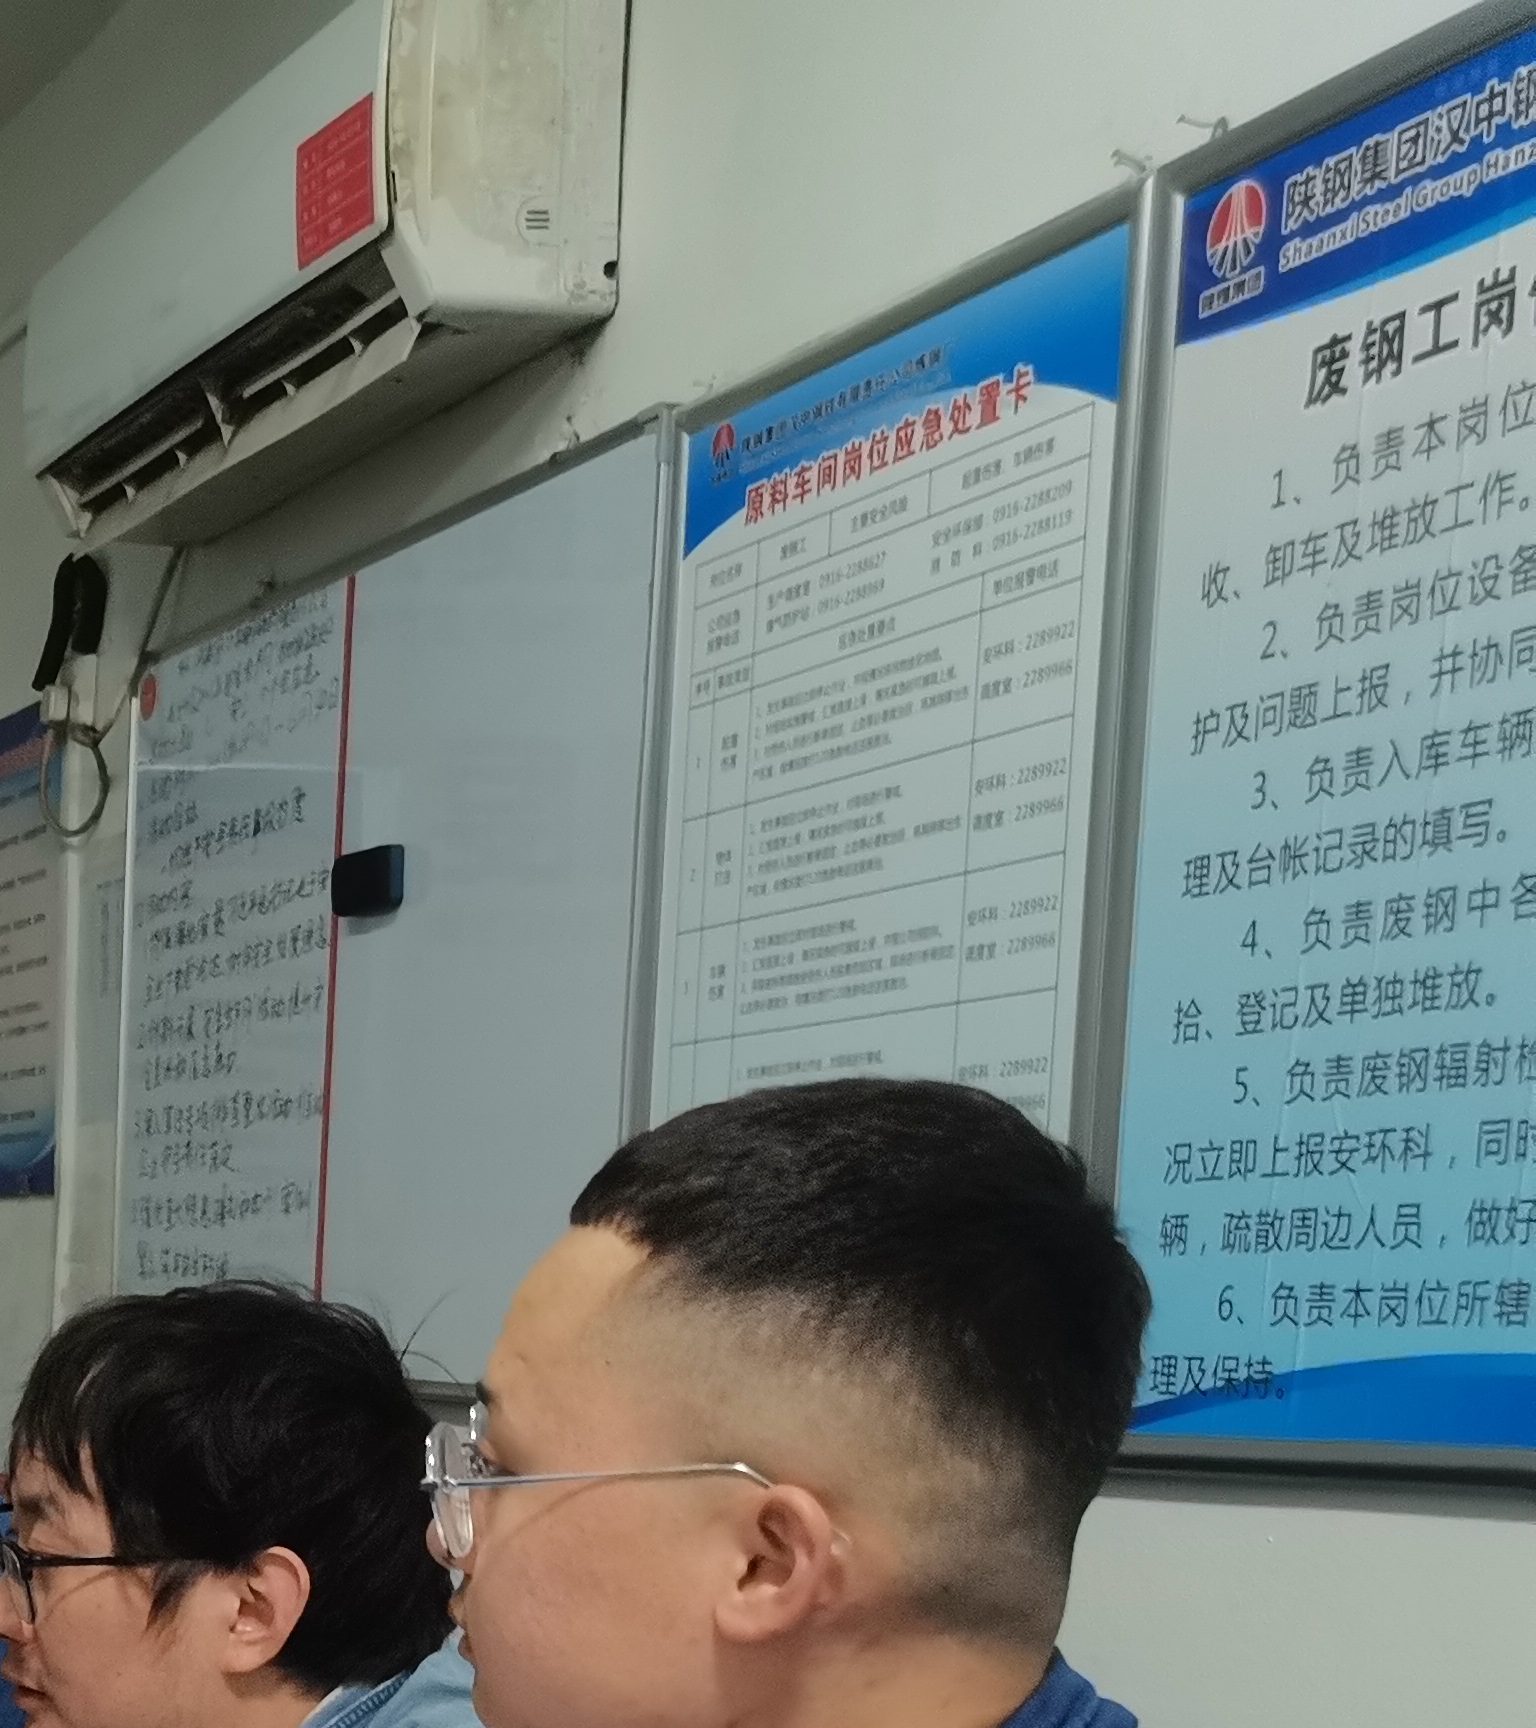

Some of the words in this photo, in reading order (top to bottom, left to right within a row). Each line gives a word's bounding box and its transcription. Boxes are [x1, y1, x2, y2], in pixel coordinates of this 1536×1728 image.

[1360, 190, 1410, 234] Steel
[1415, 166, 1479, 211] Group
[1304, 266, 1536, 409] 废钢工岗
[744, 364, 1034, 526] 原料车间岗位应急处置卡
[1201, 470, 1529, 609] 收、卸车及堆放工作。
[1190, 626, 1536, 757] 护及问题上报，并协同
[1181, 798, 1507, 899] 理及台帐记录的填写。
[1172, 961, 1498, 1045] 拾、登记及单独堆放。
[1149, 1355, 1285, 1401] 理及保持。
